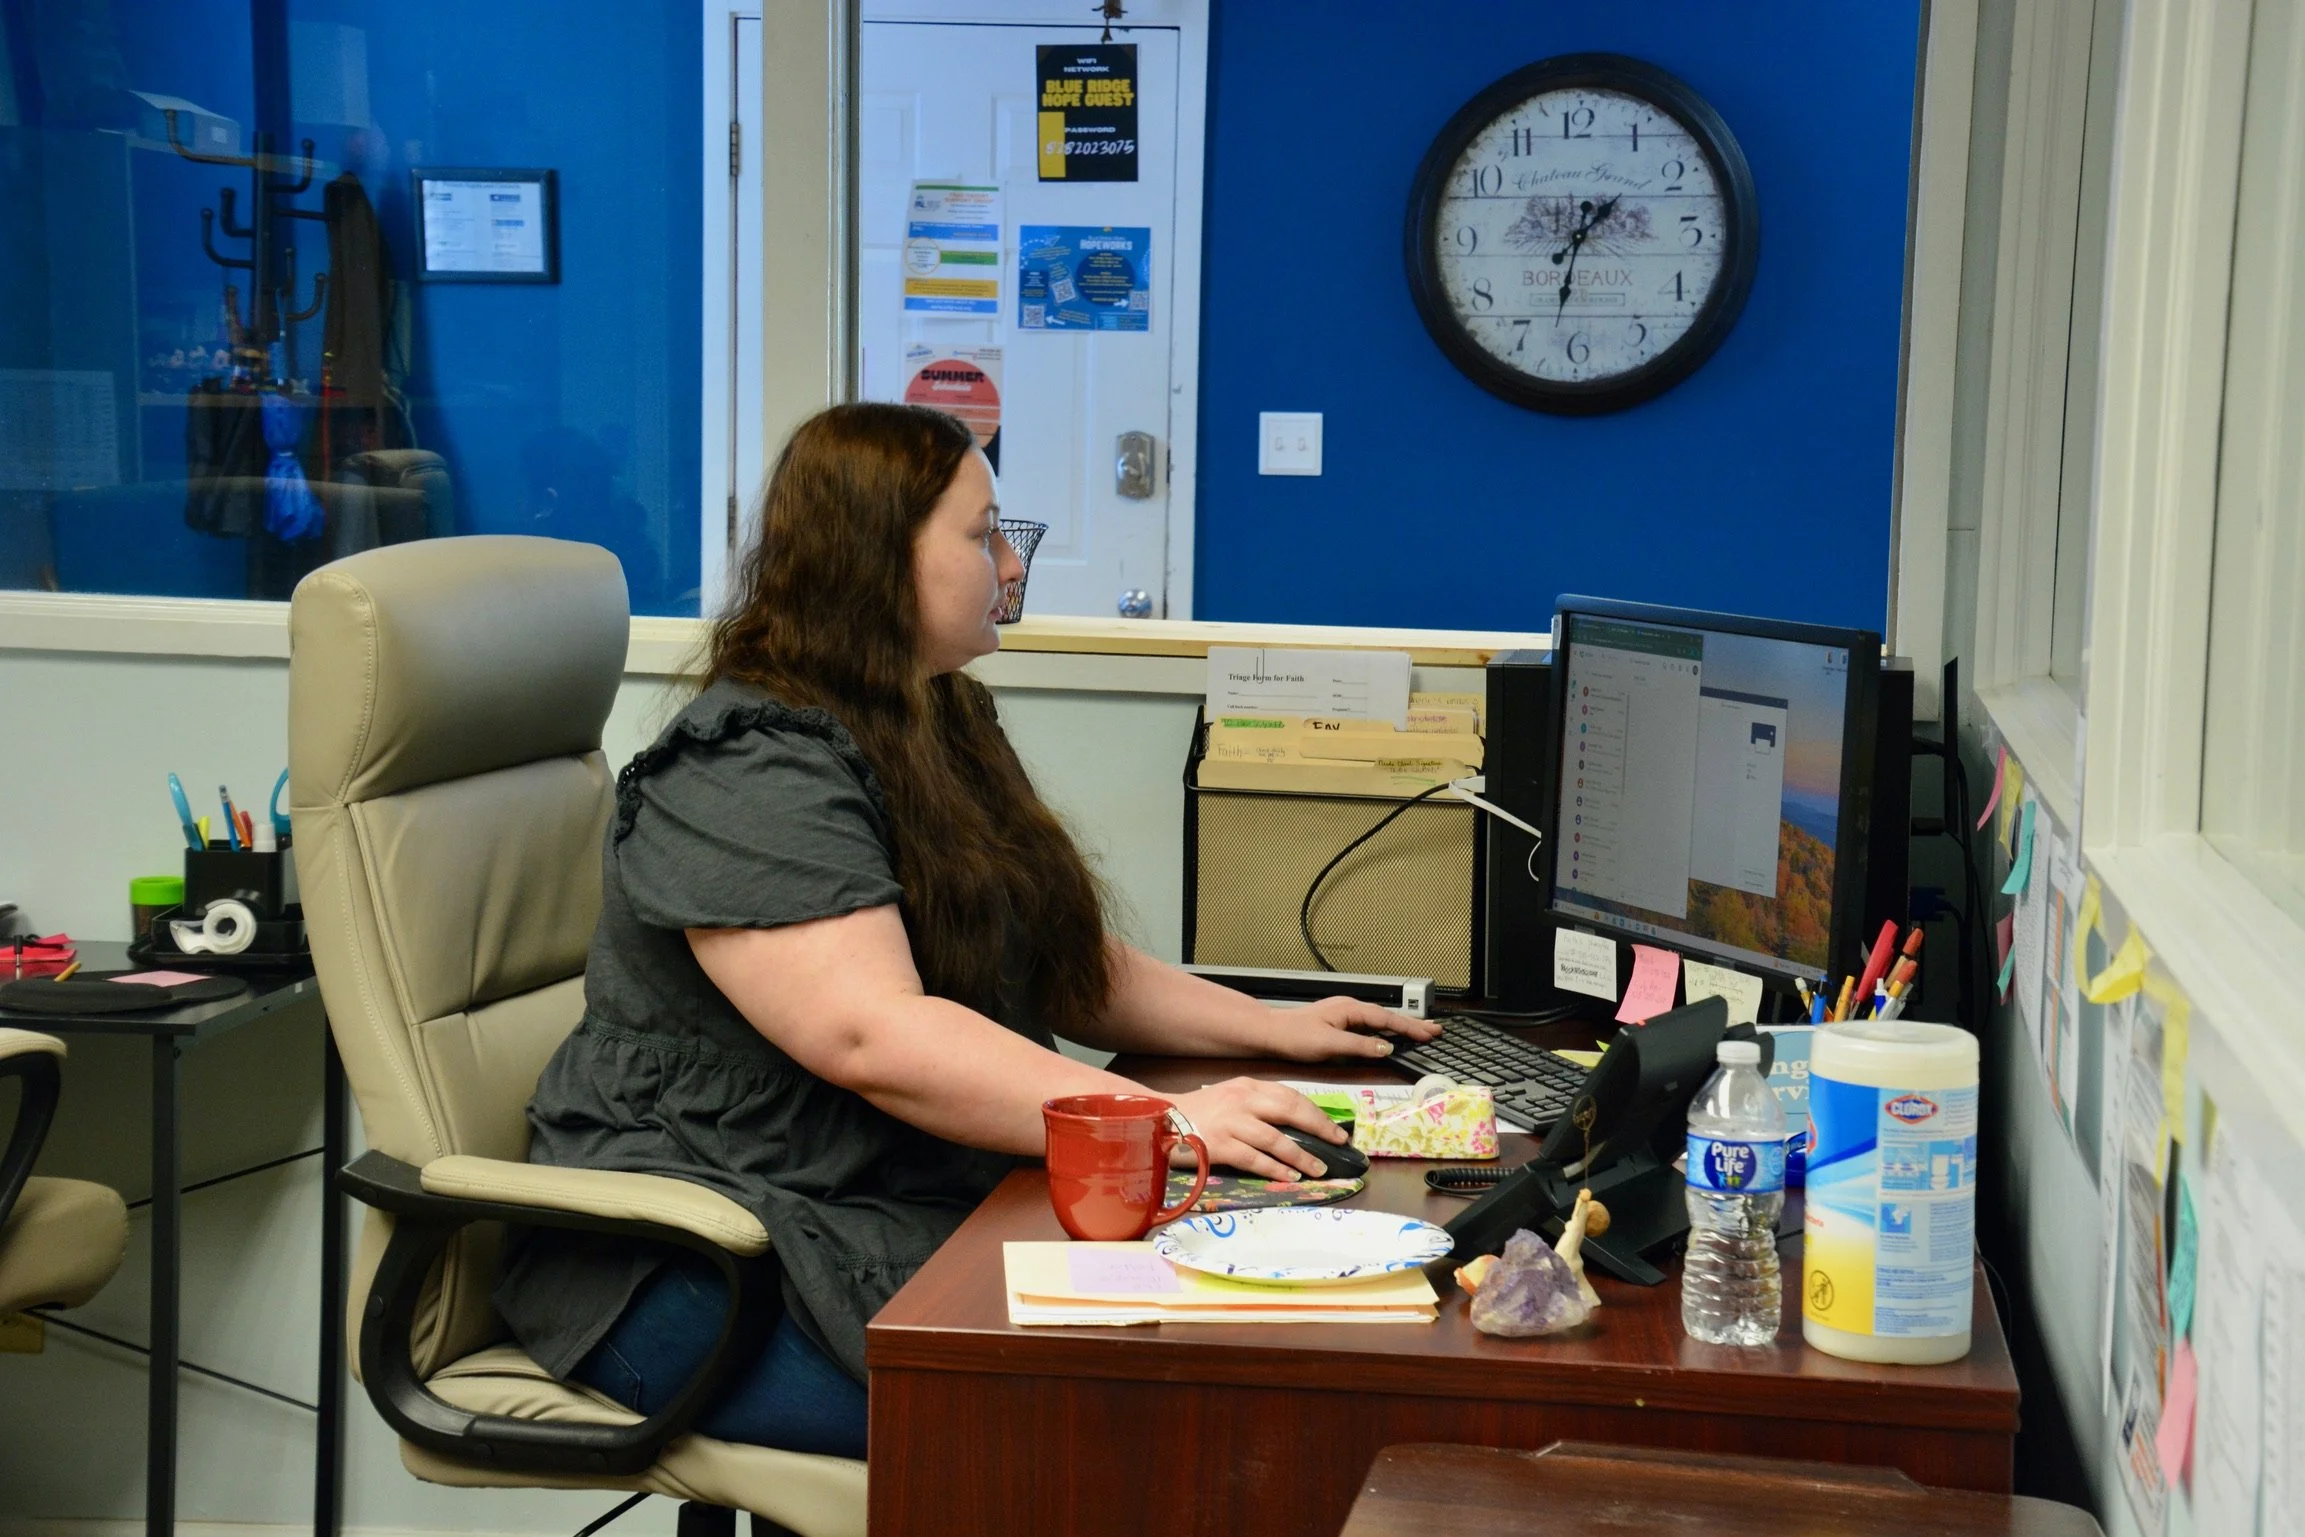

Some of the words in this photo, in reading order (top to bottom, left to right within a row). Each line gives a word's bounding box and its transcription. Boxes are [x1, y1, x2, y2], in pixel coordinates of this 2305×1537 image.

[1042, 93, 1081, 107] HOPE
[1084, 93, 1135, 107] GUEST
[1045, 79, 1083, 93] BLUE
[1087, 79, 1131, 93] RIDGE
[1064, 126, 1117, 134] PASSWORD
[1562, 107, 1596, 140] 12
[1629, 122, 1639, 153] 1
[1511, 126, 1533, 157] 11
[1471, 164, 1502, 198] 10
[1661, 159, 1685, 192] 2
[1456, 226, 1478, 256] 9
[1522, 270, 1634, 287] BORDEAUX
[1657, 270, 1688, 302] 4
[1471, 277, 1494, 312] 8
[1512, 319, 1532, 352] 7
[1625, 315, 1647, 348] 5
[1566, 330, 1590, 365] 6
[920, 369, 985, 383] SUMMER
[1228, 673, 1250, 682] Triage
[1769, 1060, 1809, 1080] ng
[1711, 1141, 1750, 1158] Pure
[1715, 1156, 1745, 1176] Life
